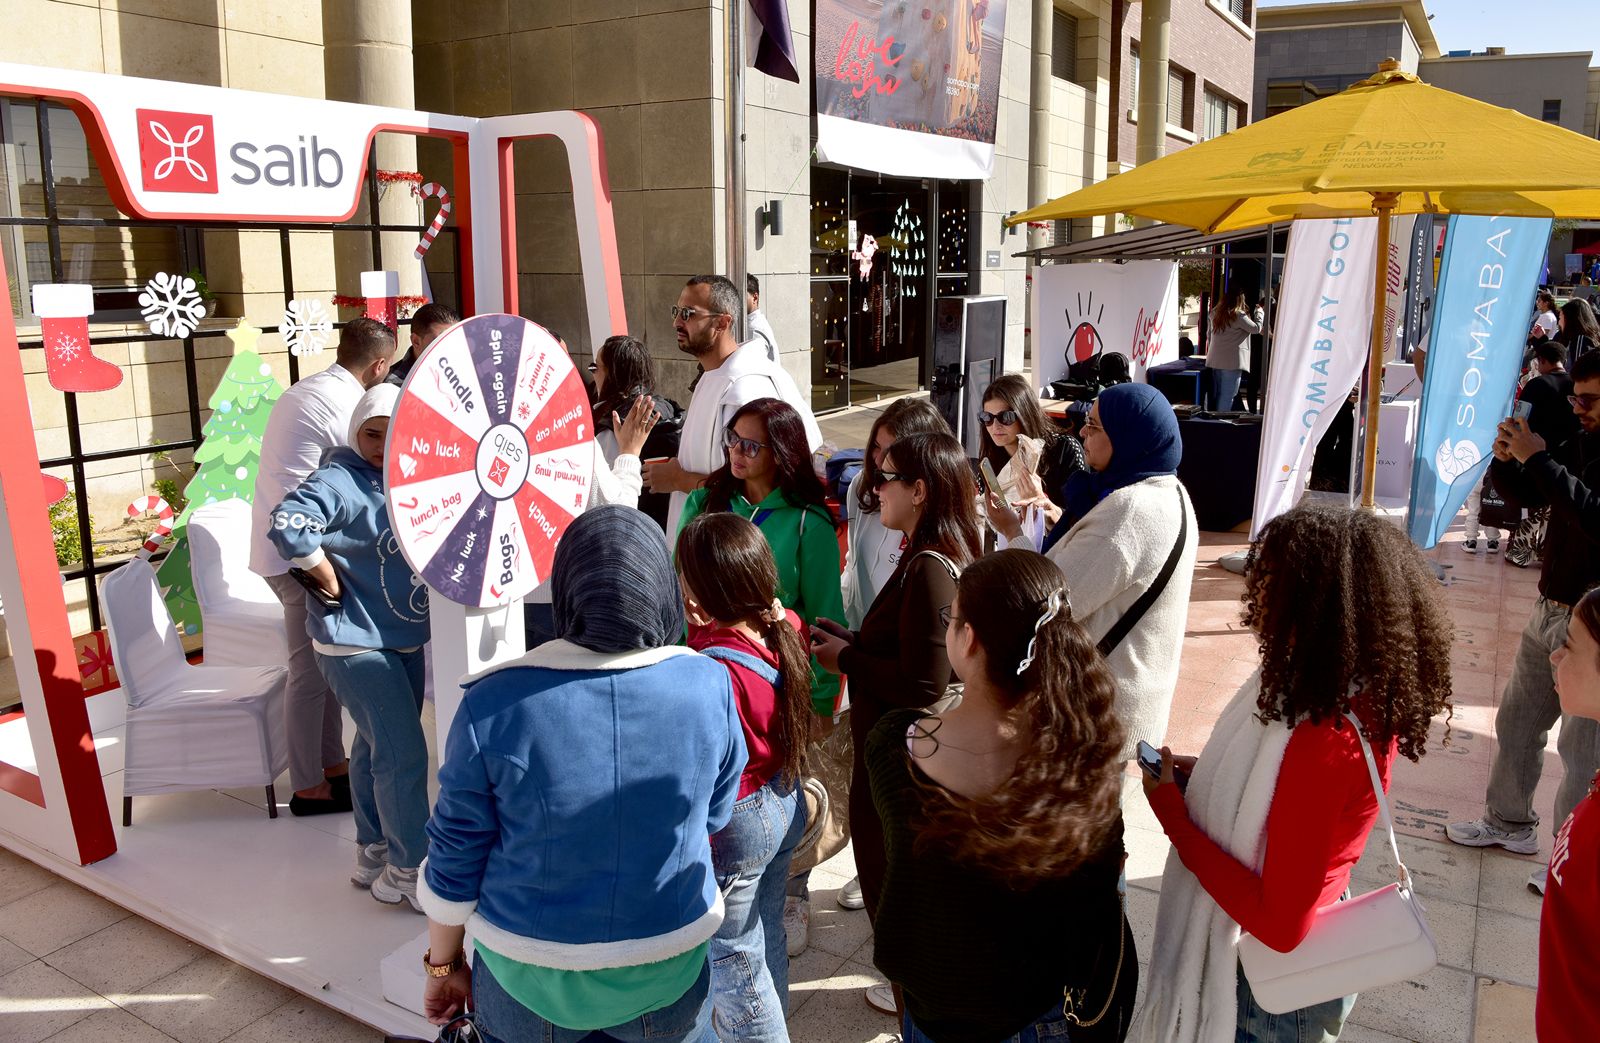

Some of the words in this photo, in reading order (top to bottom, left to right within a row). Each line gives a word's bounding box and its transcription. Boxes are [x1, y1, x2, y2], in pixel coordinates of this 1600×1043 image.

[230, 135, 343, 188] saib
[1323, 141, 1345, 152] El
[1353, 140, 1446, 151] Alsson
[1415, 229, 1424, 301] CASCADES
[1457, 216, 1512, 428] SOMABA
[489, 330, 503, 366] Spin
[438, 357, 474, 413] candle
[528, 352, 546, 393] winner
[536, 365, 555, 401] Lucky
[1299, 295, 1339, 446] OMABAY
[492, 372, 507, 415] again
[535, 428, 550, 442] cup
[553, 405, 582, 431] Stanley
[411, 437, 430, 455] No
[436, 440, 460, 458] luck
[495, 433, 523, 462] saib
[535, 464, 551, 477] mug
[554, 470, 586, 486] Thermal
[410, 504, 439, 527] lunch
[441, 492, 462, 509] bag
[528, 501, 557, 540] pouch
[451, 563, 465, 583] No
[460, 531, 477, 559] luck
[500, 533, 514, 586] Bags
